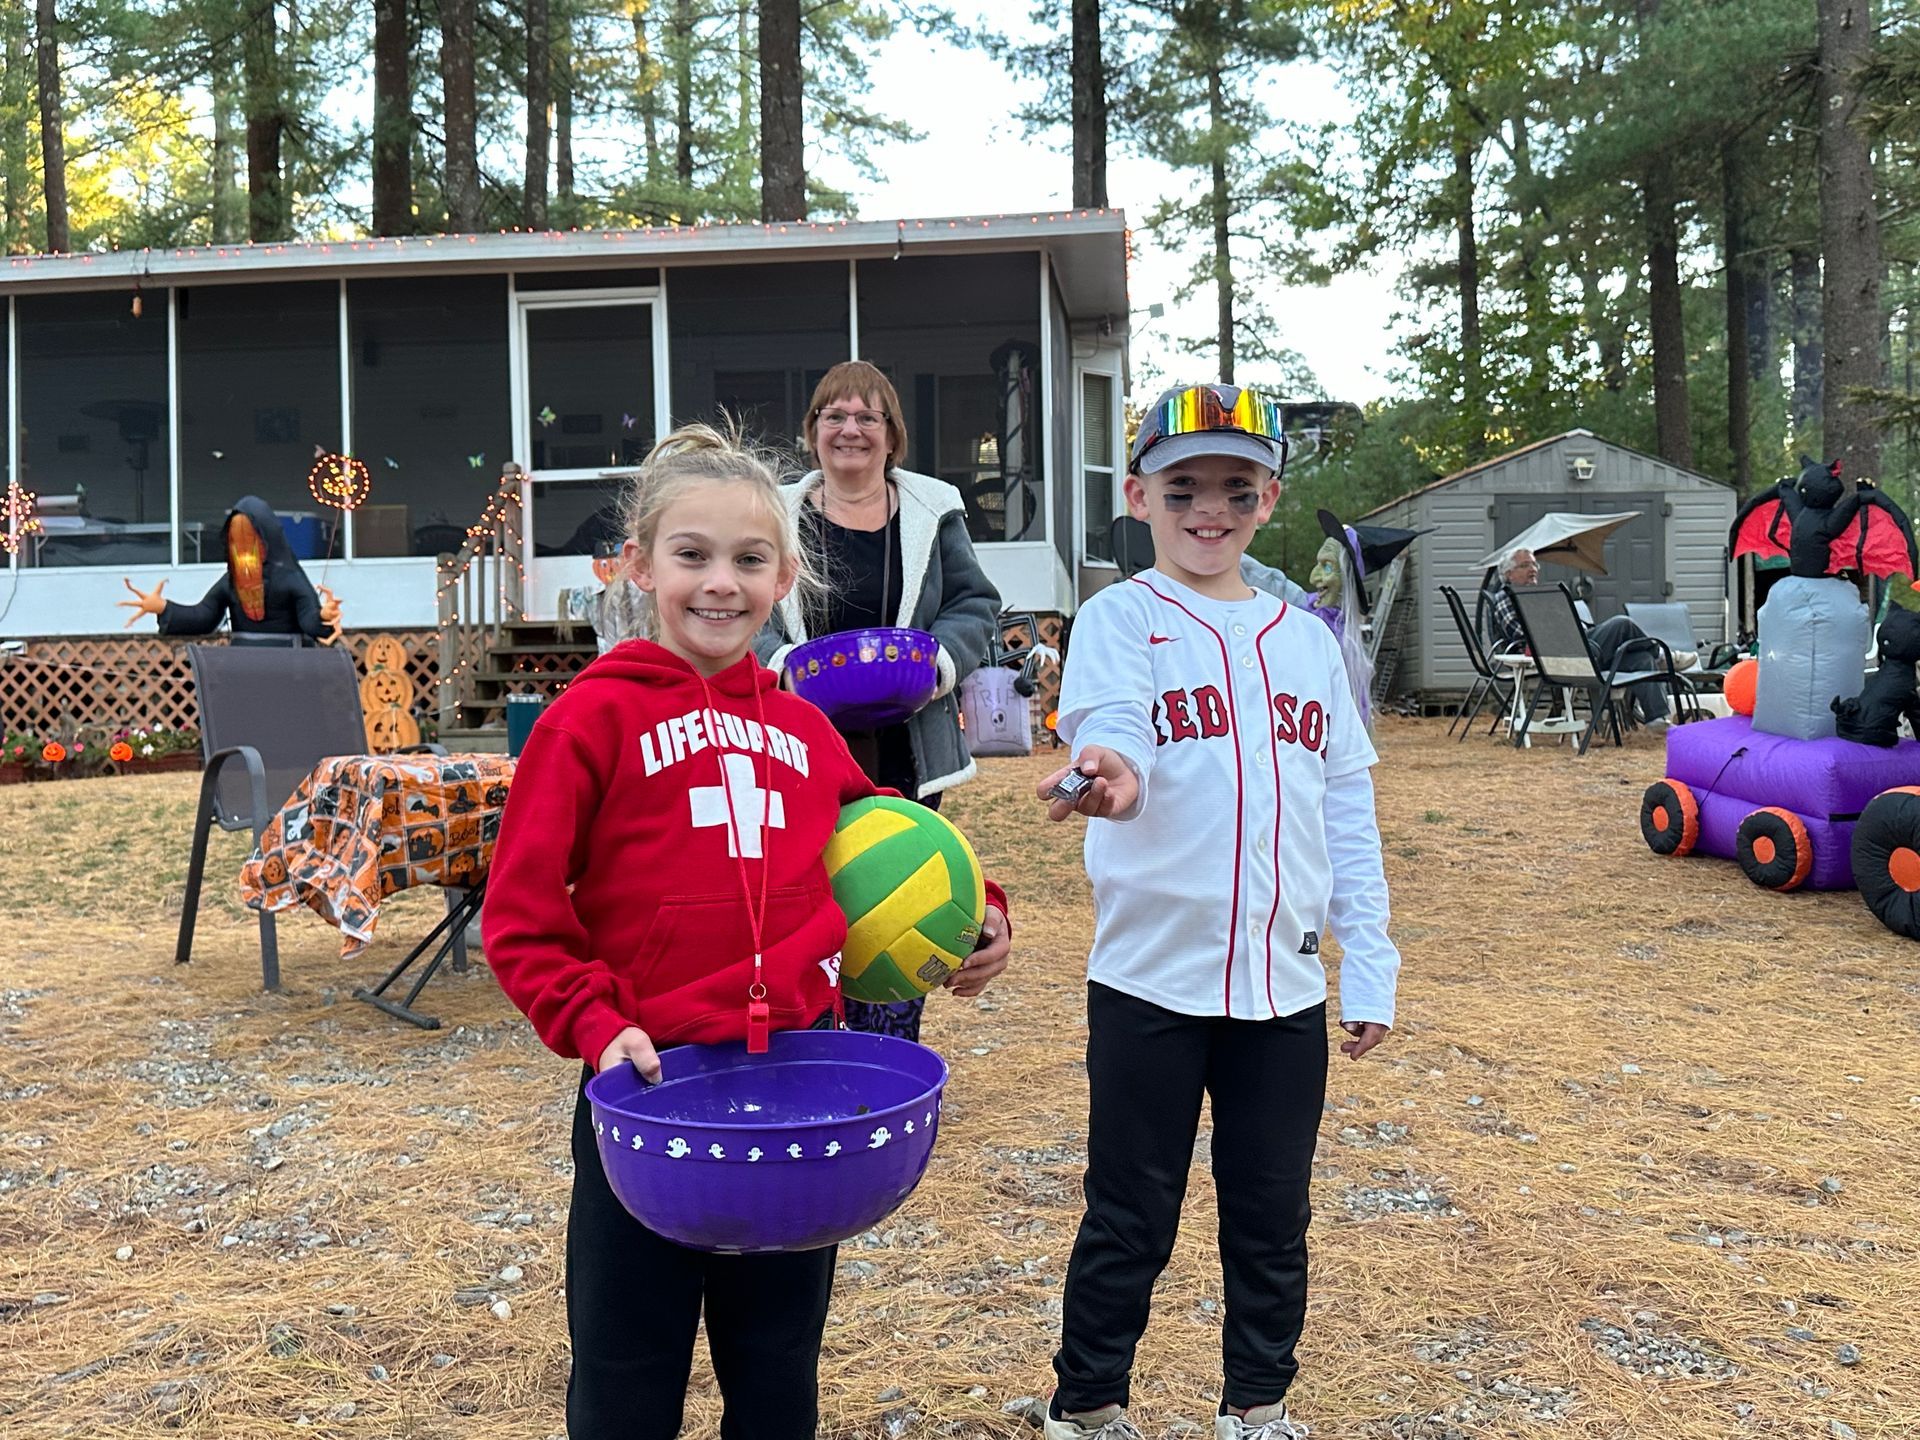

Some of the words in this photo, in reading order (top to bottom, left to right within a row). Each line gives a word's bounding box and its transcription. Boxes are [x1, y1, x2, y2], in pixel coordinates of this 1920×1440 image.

[979, 687, 1017, 708] RIP
[1273, 692, 1330, 762] SO
[639, 708, 809, 778] LIFEGUARD
